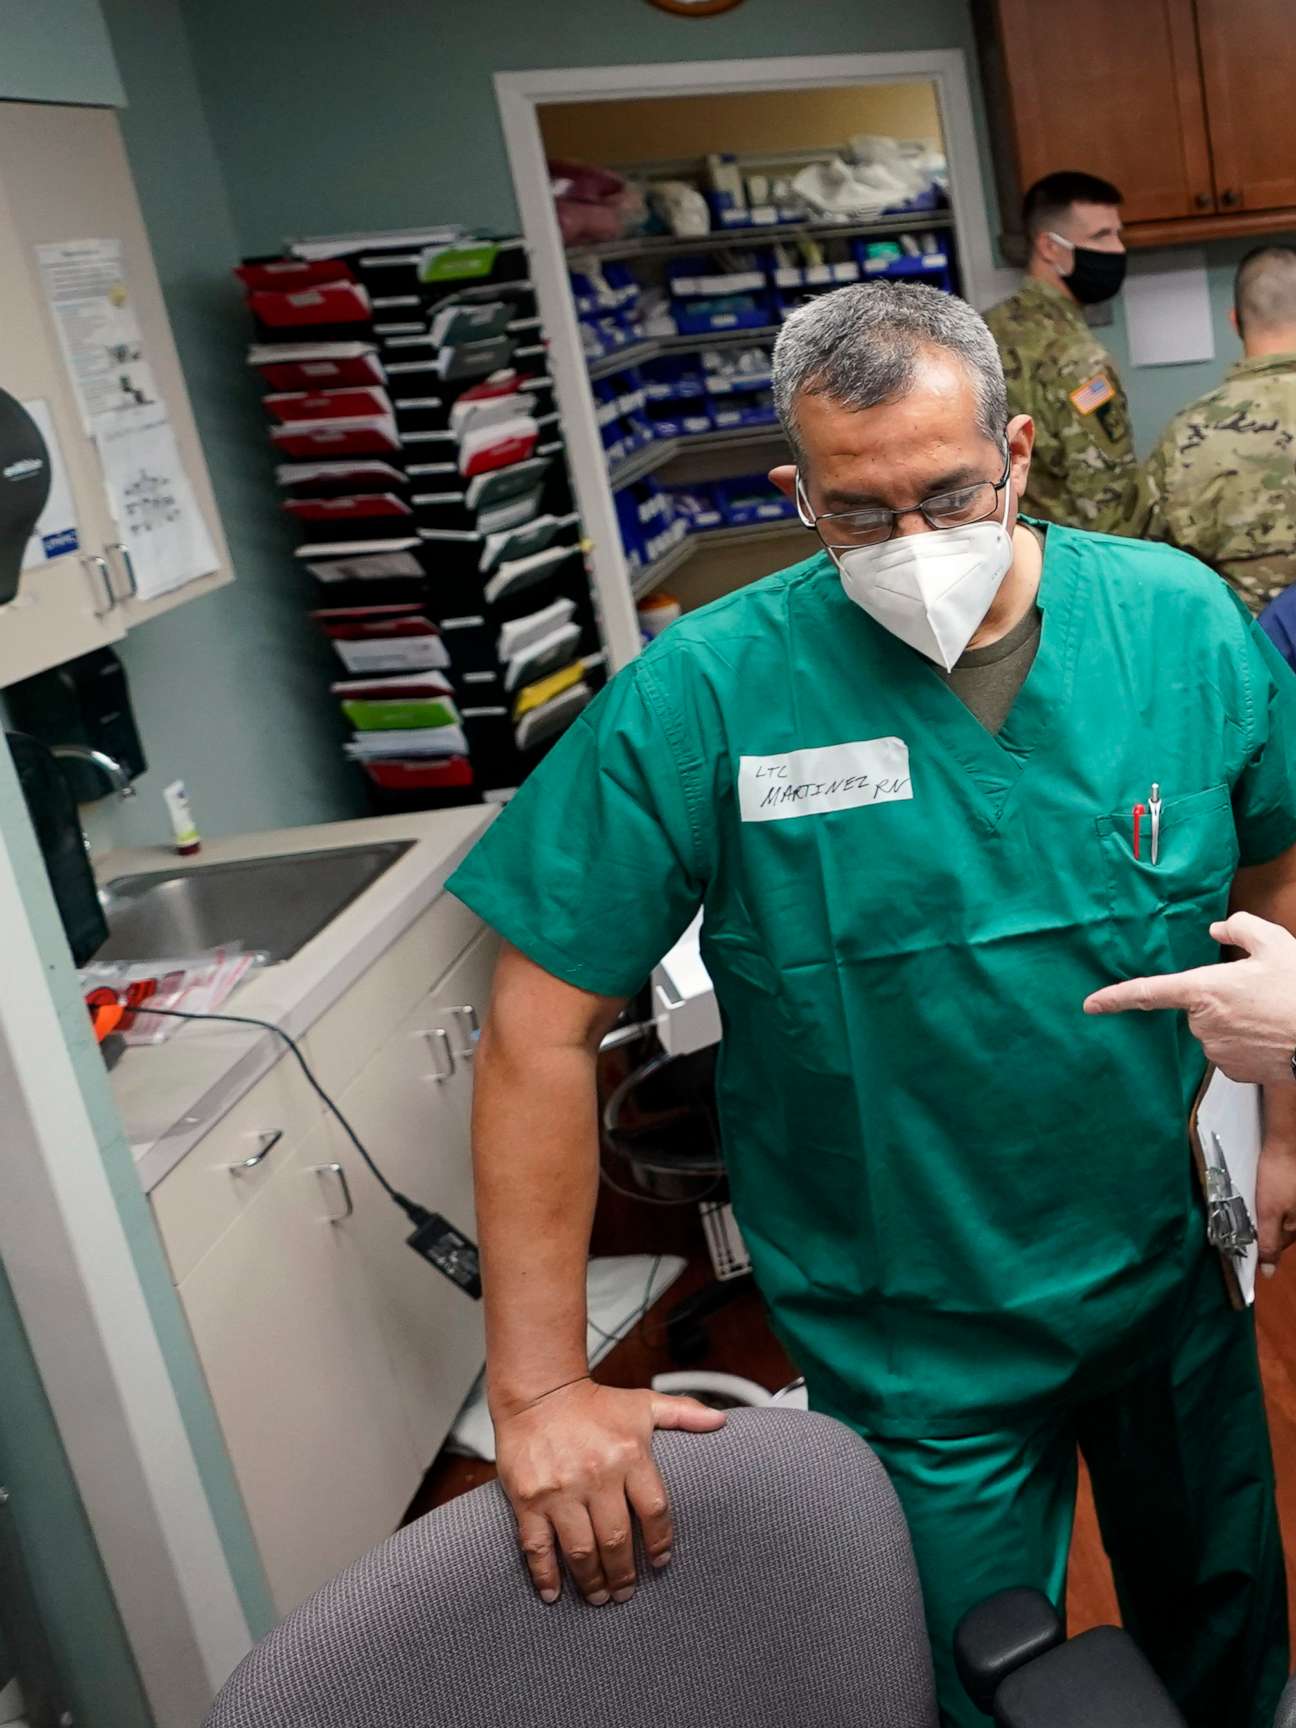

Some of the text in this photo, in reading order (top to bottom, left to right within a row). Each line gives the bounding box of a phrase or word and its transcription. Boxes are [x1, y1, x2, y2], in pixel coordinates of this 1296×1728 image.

[755, 765, 788, 779] LTC
[760, 775, 911, 808] MARTINEZ RN
